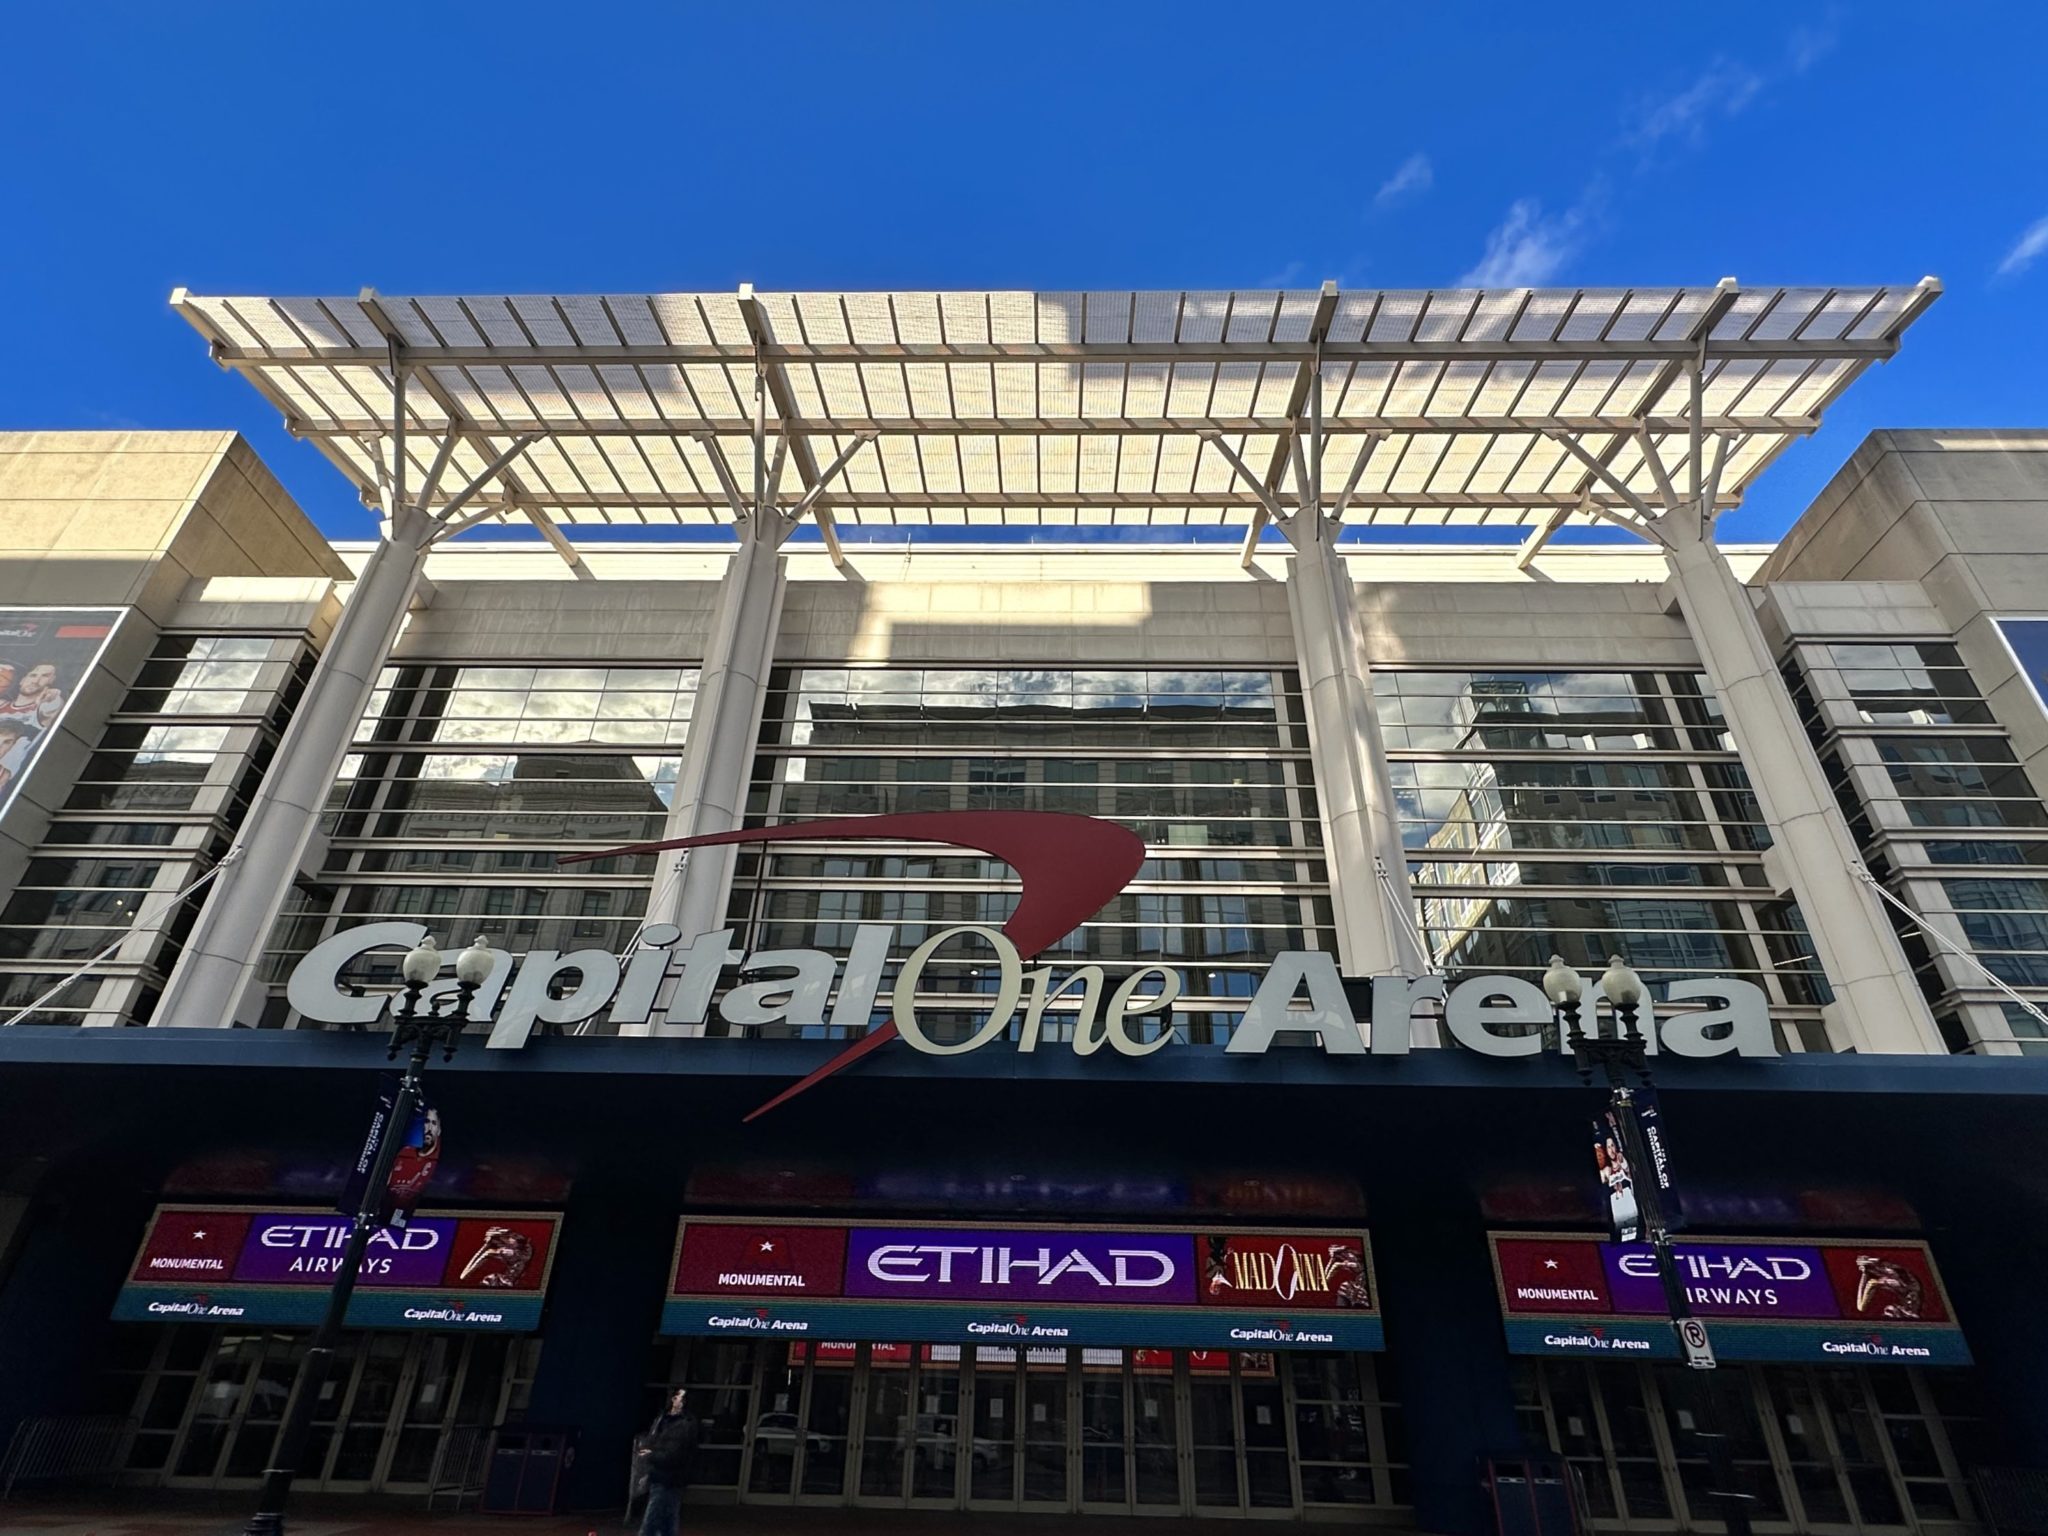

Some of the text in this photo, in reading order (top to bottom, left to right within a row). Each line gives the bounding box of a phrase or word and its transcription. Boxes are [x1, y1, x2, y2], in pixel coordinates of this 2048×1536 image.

[1224, 951, 1782, 1058] Arena
[366, 1113, 384, 1156] CAPITAL
[1650, 1125, 1665, 1171] CAPITAL
[150, 1257, 224, 1269] MONUMENTAL
[289, 1256, 392, 1274] AIRWYS
[867, 1245, 1175, 1287] ETIHAD
[1618, 1254, 1811, 1280] EIHAD
[1233, 1243, 1330, 1300] MADONNA
[718, 1273, 805, 1287] MONUMENTAL
[1517, 1288, 1599, 1301] MONUMENTAL
[208, 1305, 244, 1317] Arena
[466, 1312, 503, 1322] Arena
[771, 1319, 808, 1330] Arena
[1031, 1326, 1069, 1337] Arena
[1295, 1331, 1333, 1342] Arena
[1611, 1339, 1650, 1350] Arena
[1891, 1345, 1930, 1357] Arena
